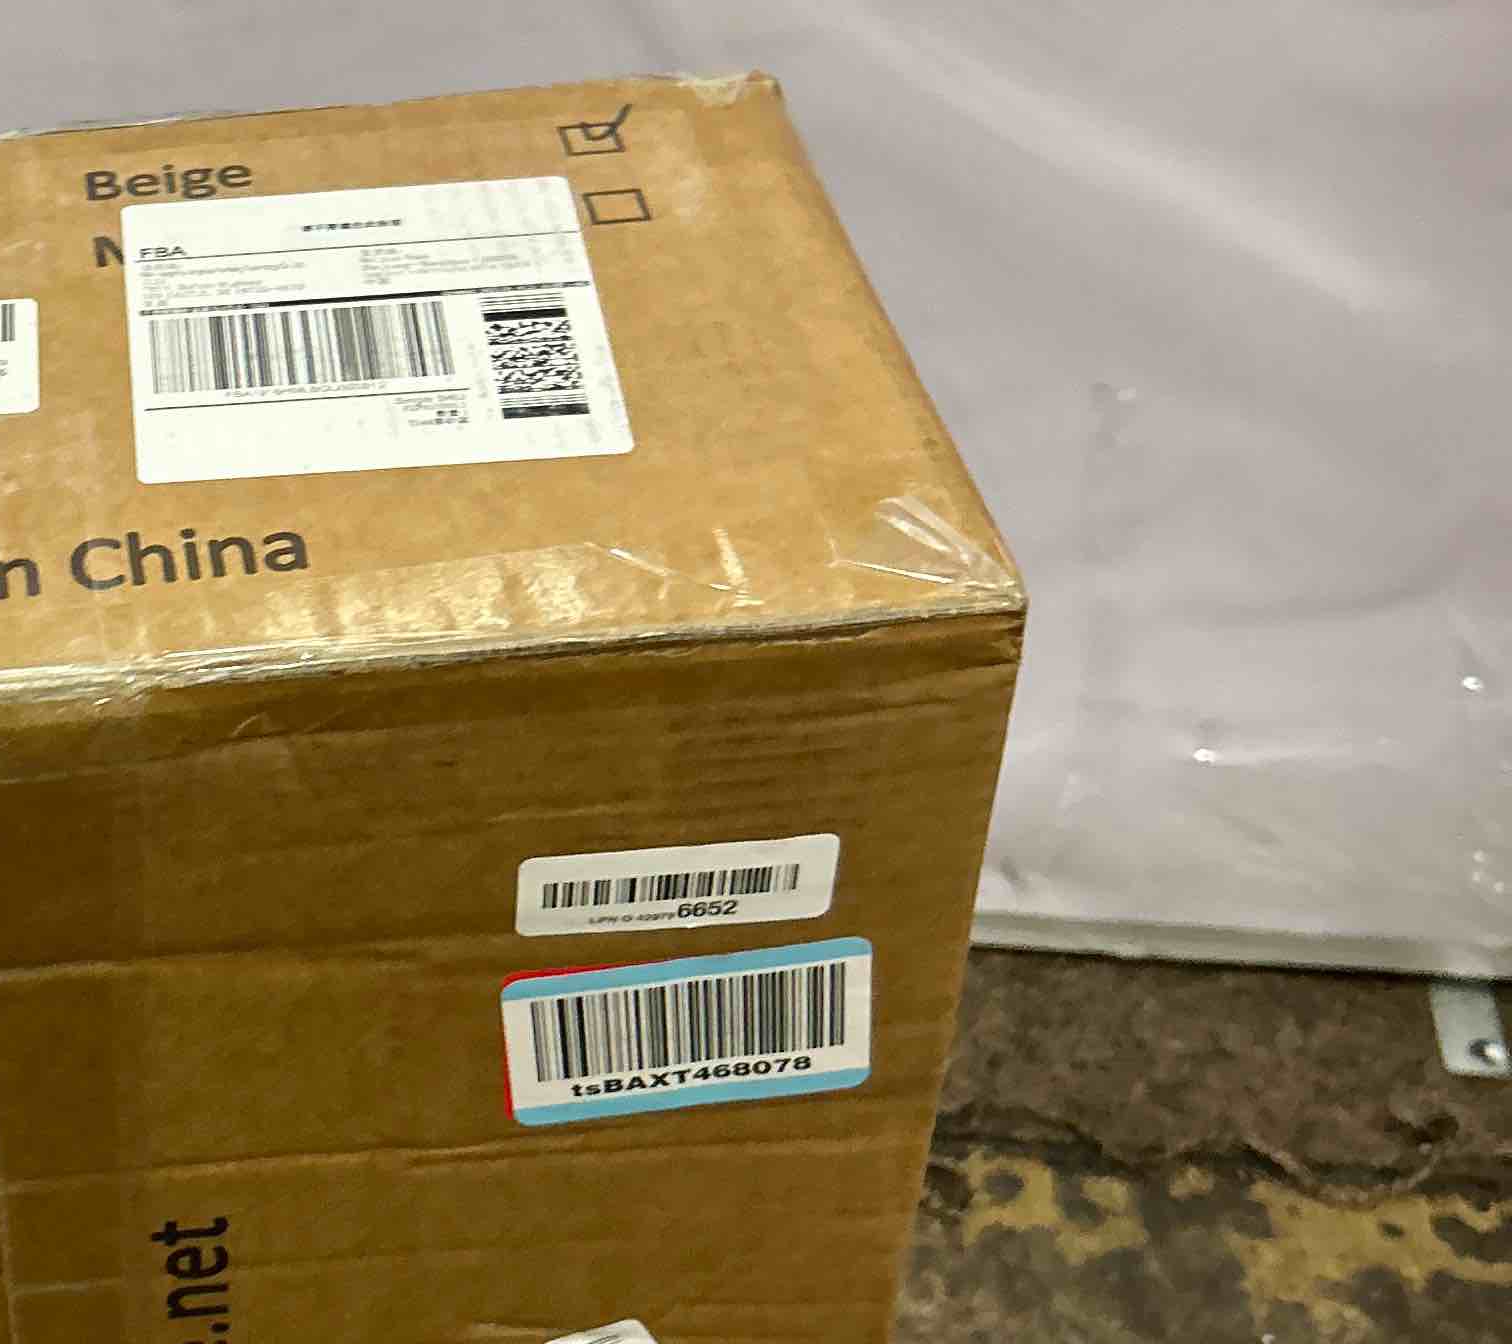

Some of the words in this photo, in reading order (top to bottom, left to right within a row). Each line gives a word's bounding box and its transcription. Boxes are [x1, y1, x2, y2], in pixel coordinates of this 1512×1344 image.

[85, 164, 253, 201] Beige
[139, 246, 188, 259] FBA
[70, 529, 309, 593] China
[677, 899, 738, 918] 6652
[571, 1055, 812, 1099] tsBAXT468078
